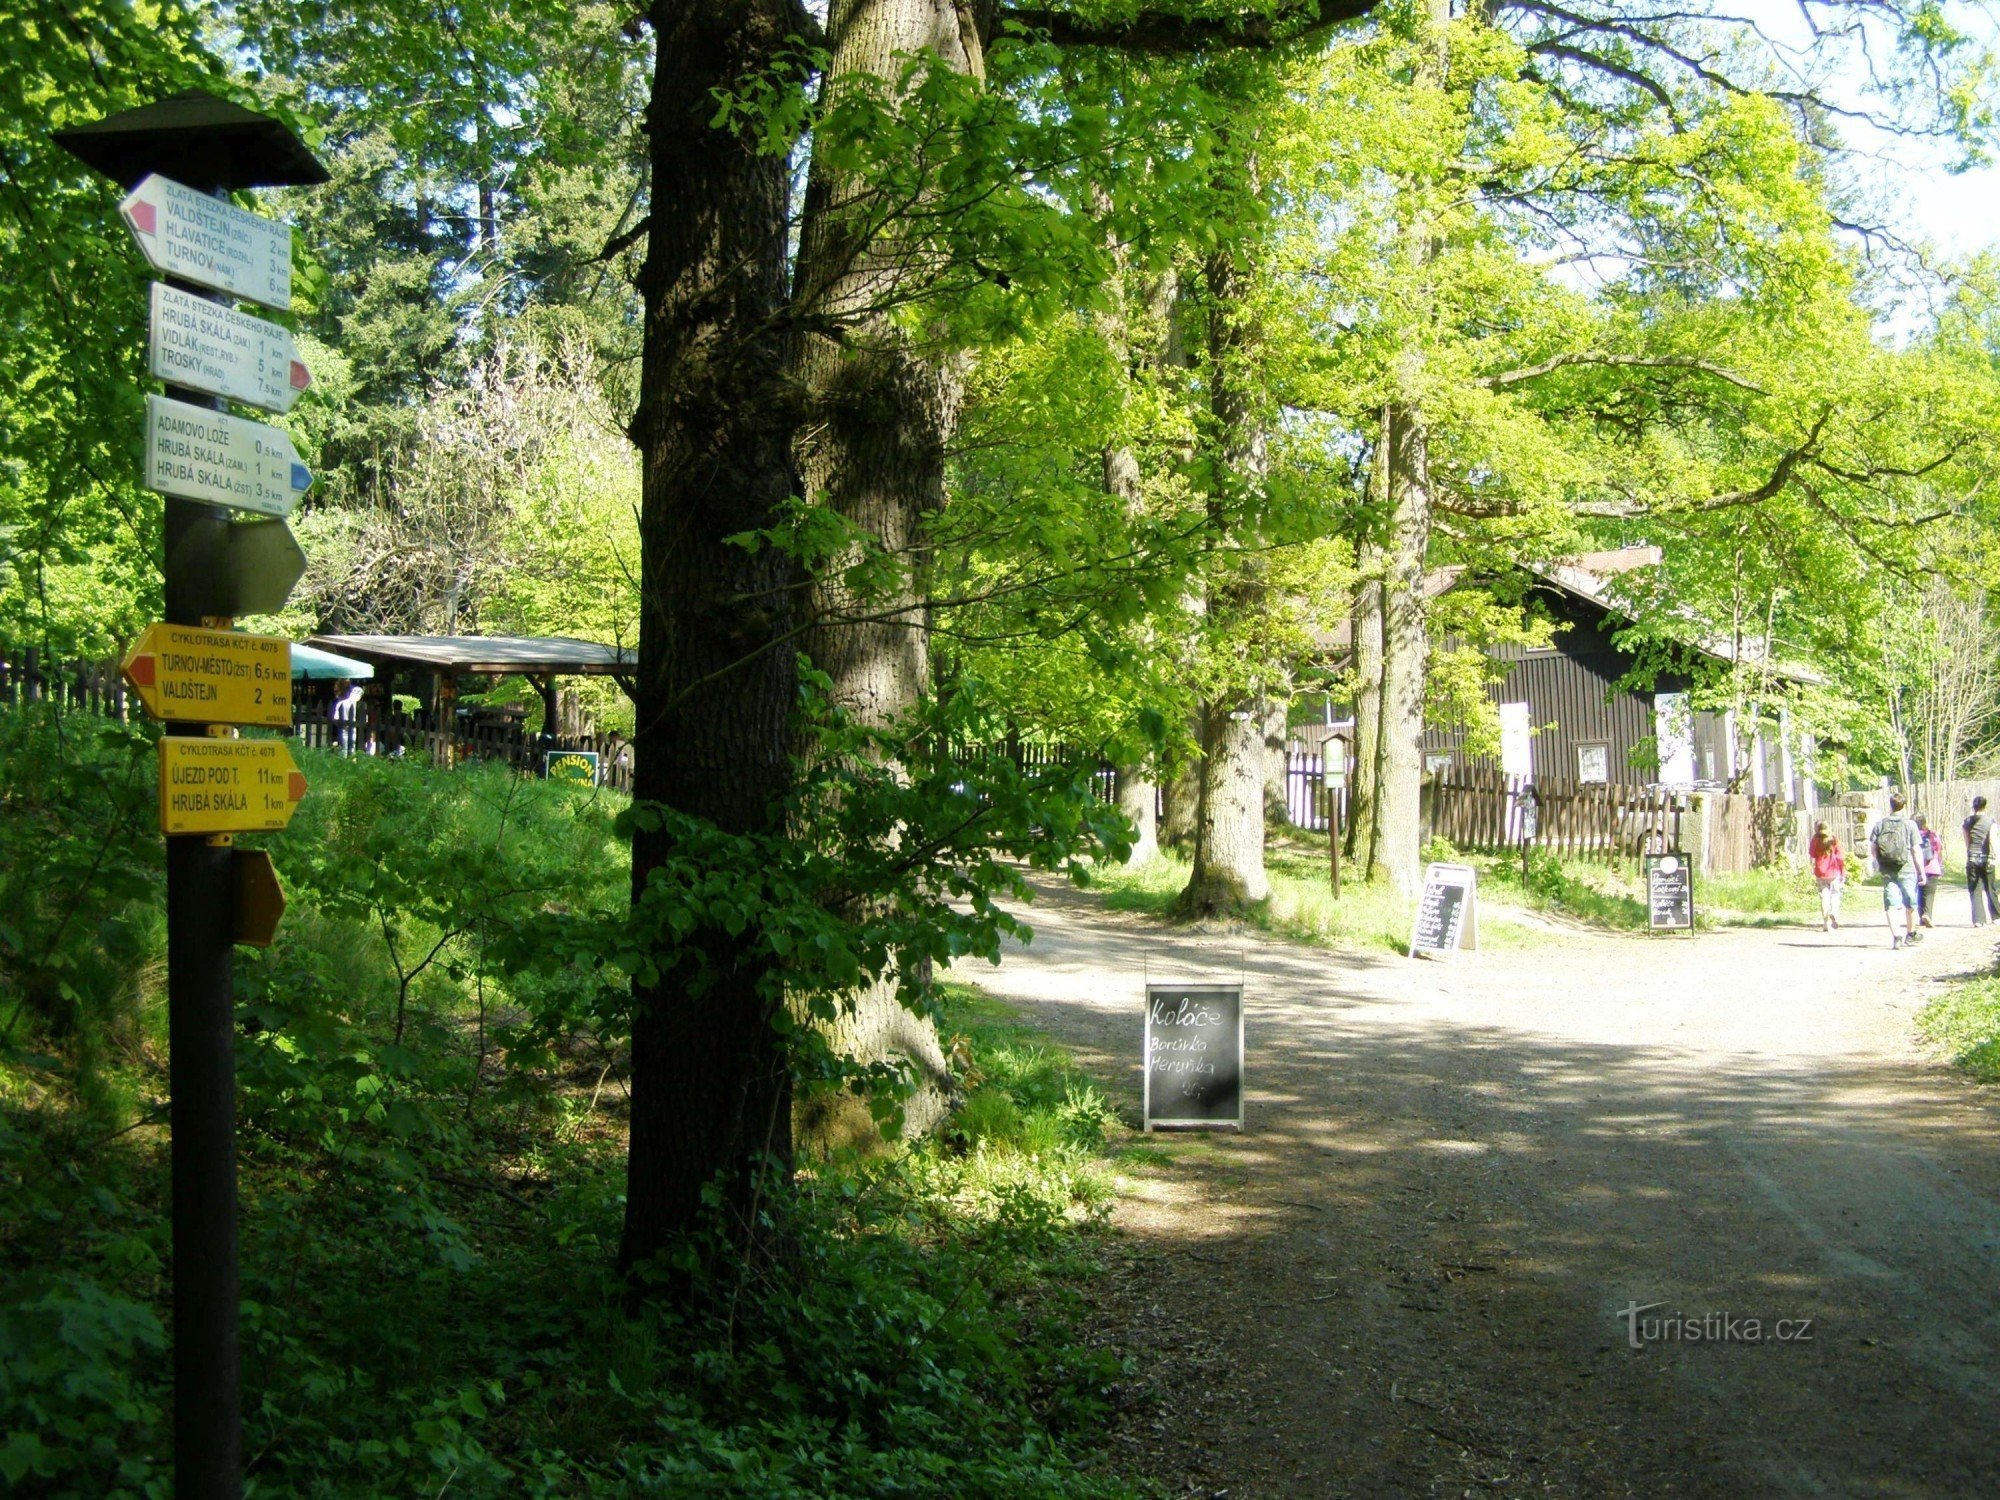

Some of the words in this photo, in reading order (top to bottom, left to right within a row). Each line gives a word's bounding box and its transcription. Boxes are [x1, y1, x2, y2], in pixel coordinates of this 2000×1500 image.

[166, 185, 194, 204] ZLATÁ
[194, 196, 228, 217] STEZKA
[229, 208, 268, 232] ČESKÉHO
[269, 222, 290, 241] RÁJE
[166, 200, 230, 237] VALDŠTEJN
[269, 240, 277, 256] 2
[277, 246, 289, 259] km
[166, 220, 226, 256] HLAVATICE
[269, 258, 277, 274] 3
[277, 265, 289, 278] km
[166, 240, 215, 271] TURNOV
[269, 278, 277, 293] 6
[277, 285, 289, 297] km
[162, 307, 198, 332] HRUBÁ
[200, 320, 232, 343] SKÁLA
[258, 340, 265, 353] 1
[272, 348, 283, 360] km
[163, 291, 190, 309] ZLATÁ
[191, 301, 225, 319] STEZKA
[225, 312, 262, 334] ČESKÉHO
[264, 326, 284, 341] RÁJE
[162, 328, 199, 352] VIDLÁK
[258, 359, 265, 373] 5
[272, 366, 283, 379] km
[162, 347, 203, 373] TROSKY
[203, 365, 225, 382] (HRAD)
[271, 385, 282, 398] km
[158, 415, 205, 440] ADAMOVO
[207, 425, 230, 446] LOŽE
[271, 449, 283, 459] km
[158, 437, 192, 460] HRUBÁ
[194, 445, 225, 467] SKÁLA
[256, 461, 262, 475] 1
[271, 470, 283, 480] km
[157, 459, 195, 482] HRUBÁ
[197, 468, 233, 491] SKÁLA
[234, 481, 253, 498] (ŽST)
[271, 491, 283, 502] km
[171, 632, 231, 648] CYKLOTRASA
[232, 637, 250, 650] KČT
[259, 643, 279, 653] 4078
[162, 653, 233, 676] TURNOV-MĚSTO
[255, 662, 270, 680] 6,5
[272, 670, 287, 681] km
[162, 678, 217, 701] VALDŠTEJN
[254, 688, 262, 704] 2
[272, 694, 287, 706] km
[180, 744, 233, 757] CYKLOTRASA
[235, 745, 250, 757] KČT
[259, 747, 276, 757] 4078
[550, 755, 595, 778] PENSION
[172, 763, 205, 784] ÚJEZD
[208, 767, 230, 784] POD
[232, 768, 240, 784] T.
[257, 768, 269, 784] 11
[270, 771, 284, 784] km
[172, 789, 210, 811] HRUBÁ
[213, 789, 248, 811] SKÁLA
[263, 793, 269, 810] 1
[270, 798, 284, 810] km
[1150, 997, 1224, 1027] Koláče
